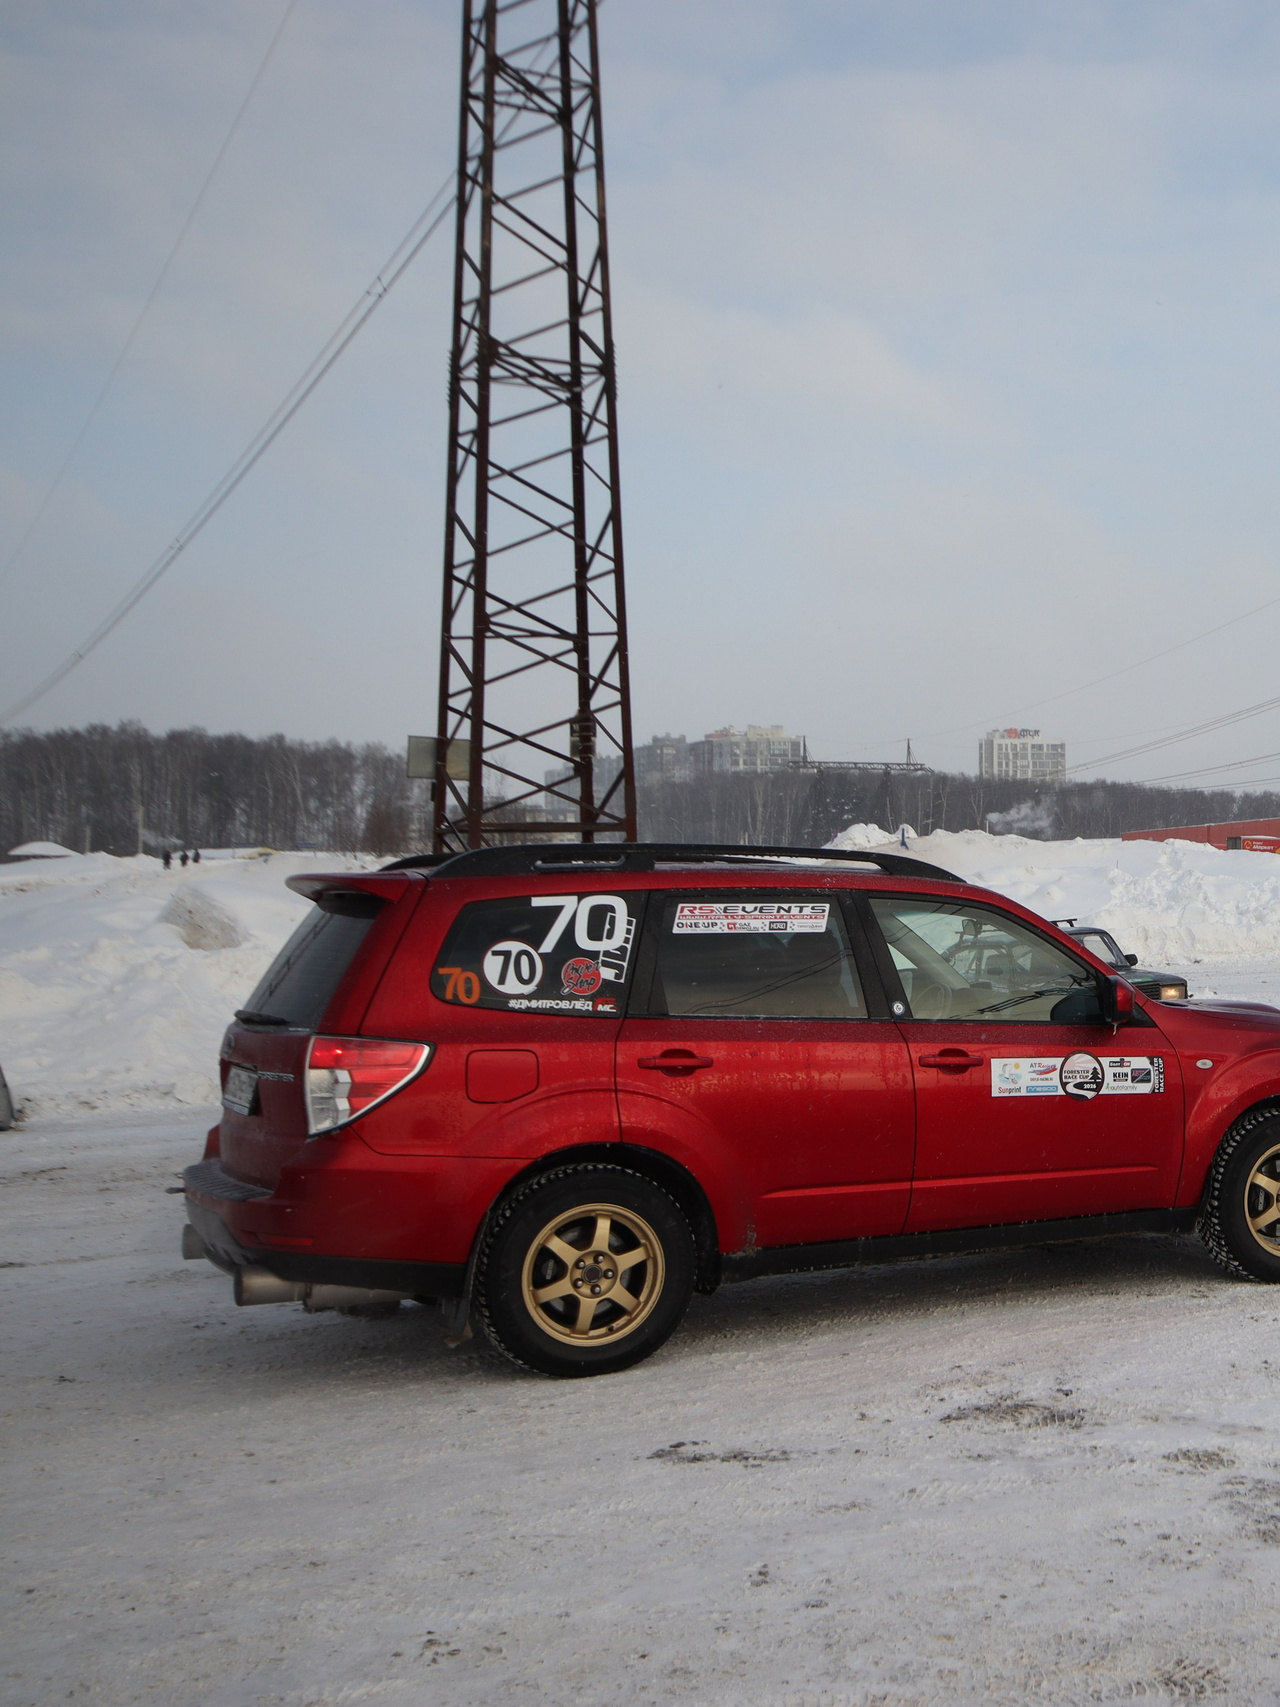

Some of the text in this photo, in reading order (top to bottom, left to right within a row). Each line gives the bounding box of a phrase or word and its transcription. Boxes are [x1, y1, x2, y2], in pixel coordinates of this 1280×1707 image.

[680, 906, 827, 914] RS EVENTS
[531, 895, 628, 953] 70
[491, 949, 537, 986] 70
[437, 967, 481, 1004] 70
[508, 998, 593, 1011] #ДМИТРОВЛЁД
[998, 1086, 1022, 1095] Sunprint
